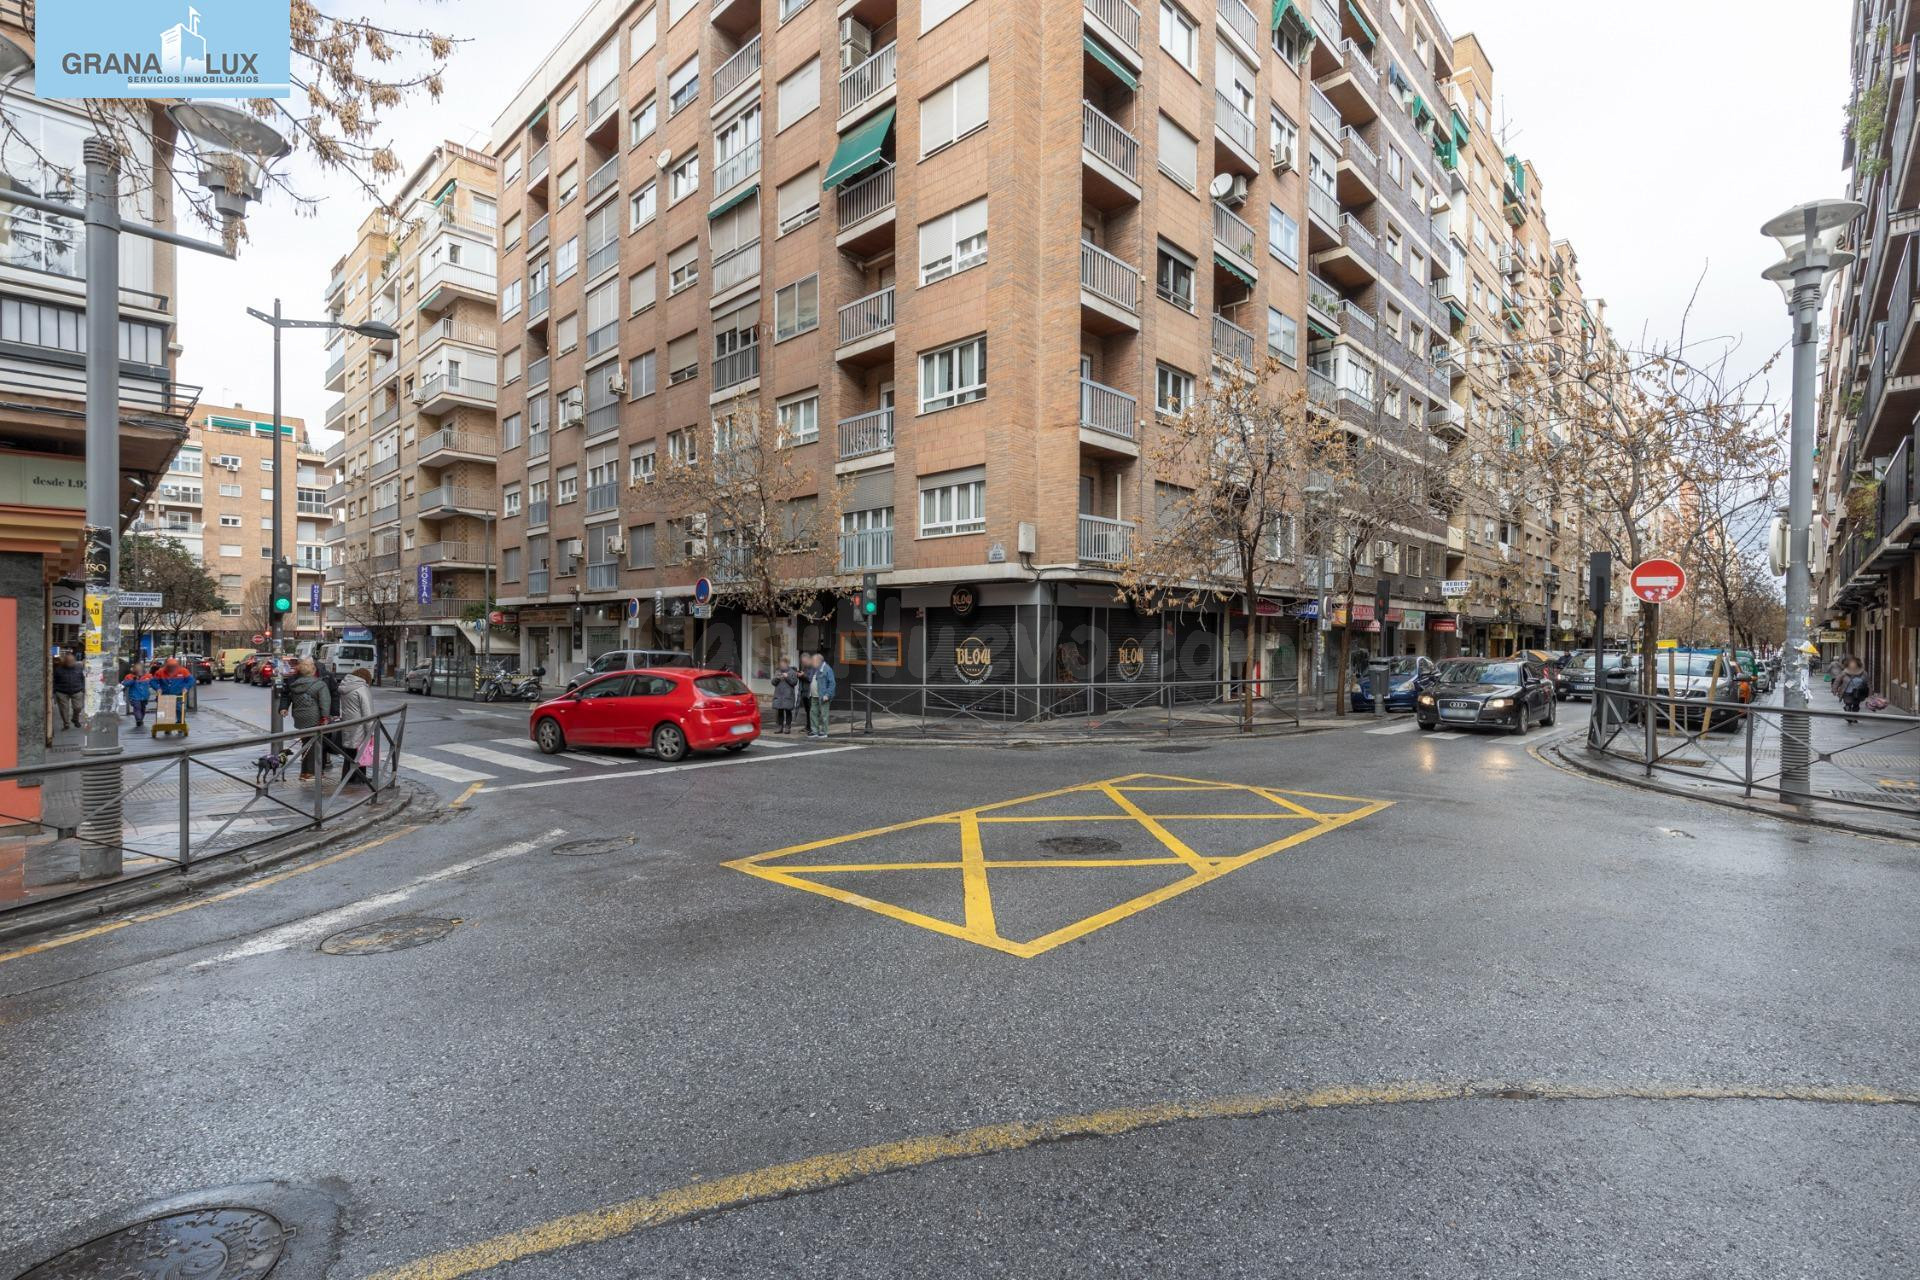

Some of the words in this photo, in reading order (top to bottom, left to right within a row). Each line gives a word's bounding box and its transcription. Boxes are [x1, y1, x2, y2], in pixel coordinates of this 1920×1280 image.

[33, 476, 65, 487] desde
[52, 600, 80, 608] odo
[955, 647, 991, 665] BLOW
[1119, 648, 1144, 664] BLOW
